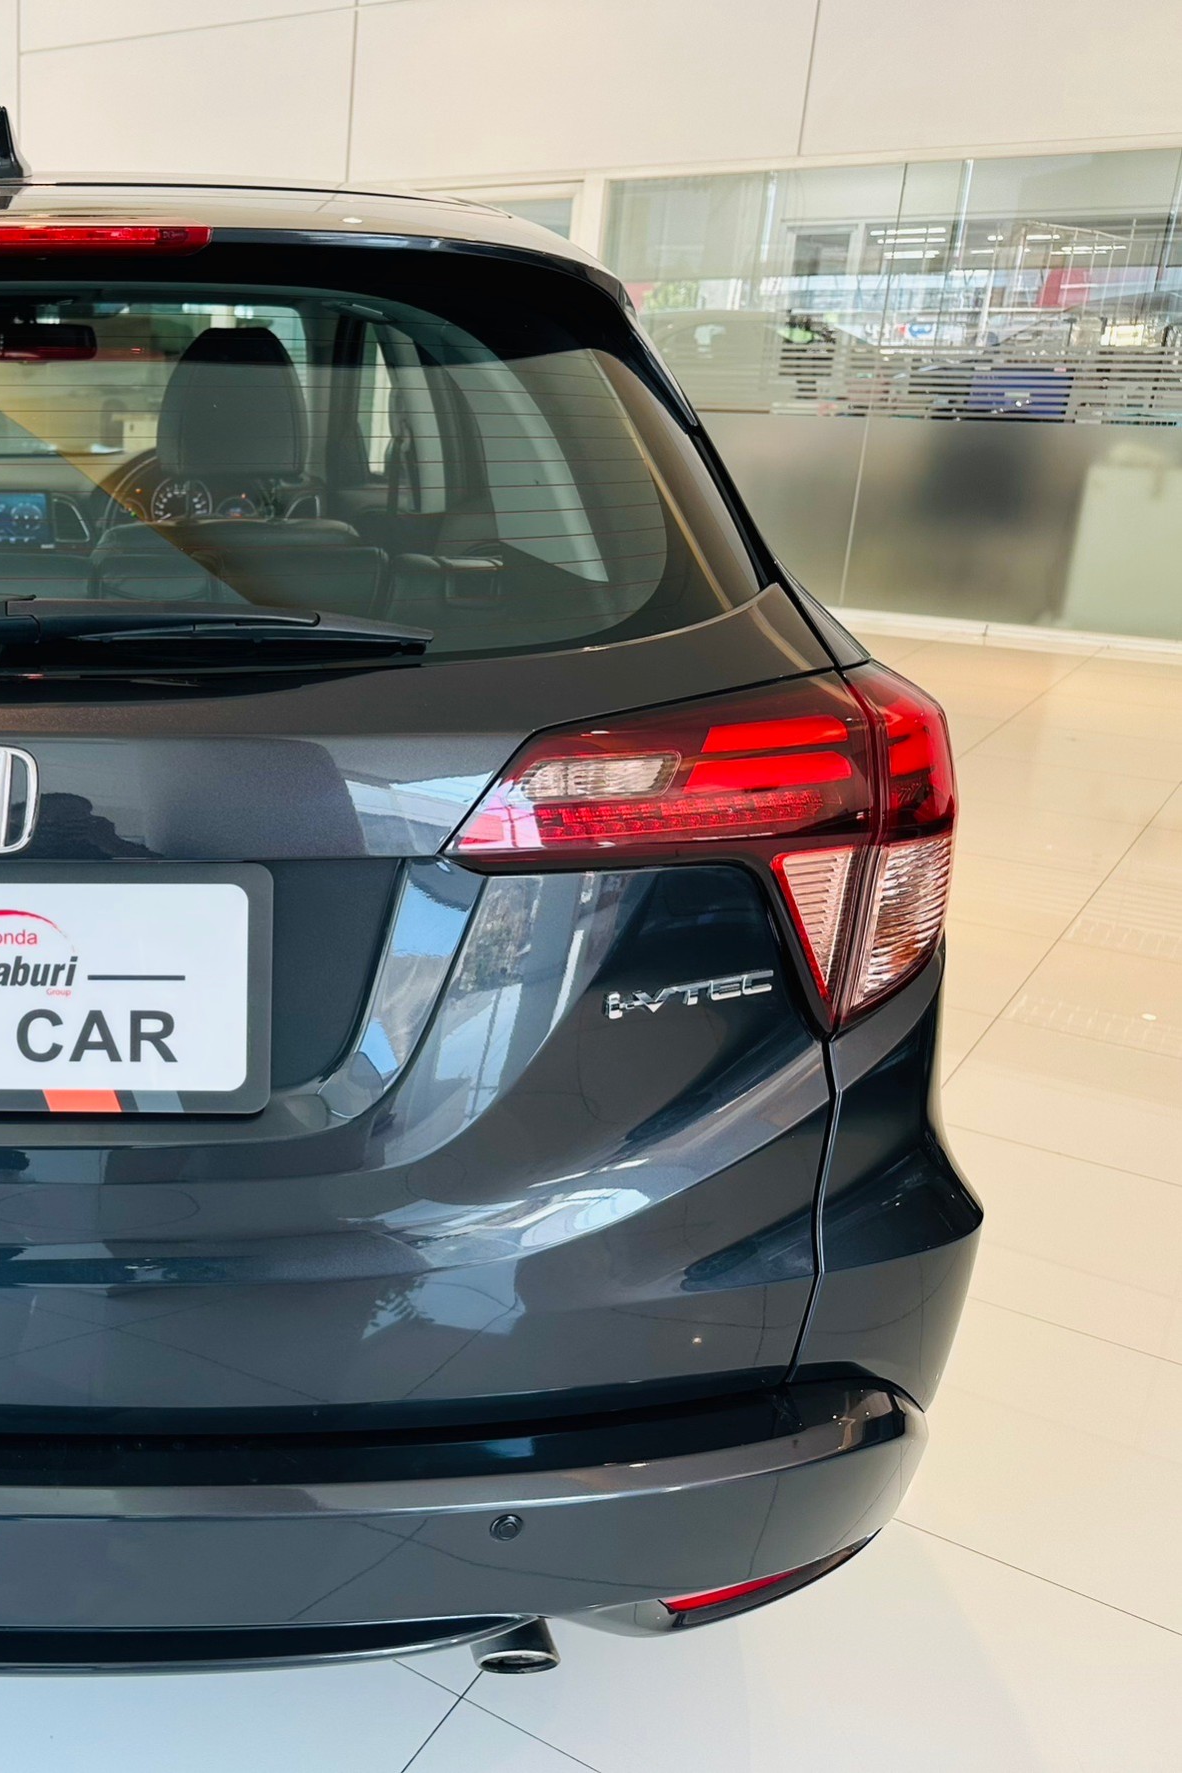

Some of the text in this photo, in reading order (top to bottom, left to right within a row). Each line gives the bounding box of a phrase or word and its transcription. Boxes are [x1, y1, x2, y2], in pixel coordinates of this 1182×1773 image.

[45, 987, 72, 997] Group
[605, 969, 775, 1020] i-VTEC
[16, 1008, 179, 1063] CAR
